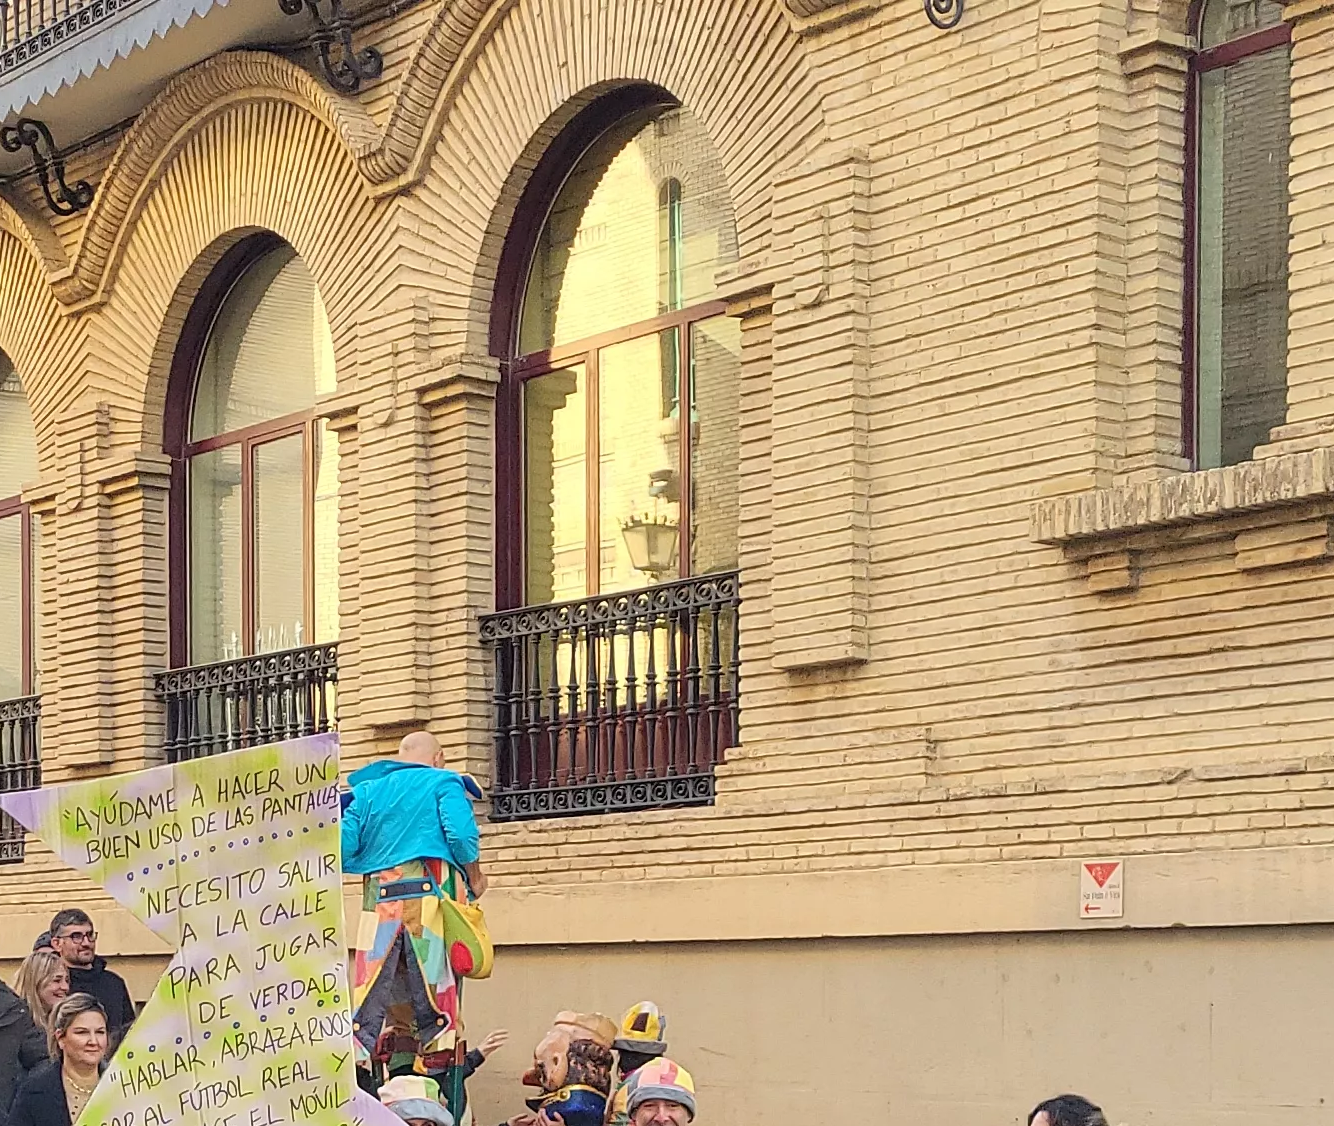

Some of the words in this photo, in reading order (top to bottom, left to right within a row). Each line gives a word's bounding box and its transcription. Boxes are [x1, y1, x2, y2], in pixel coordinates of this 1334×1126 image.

[191, 783, 206, 808] A
[217, 768, 286, 803] HACER
[295, 754, 332, 786] UN
[85, 829, 141, 865] BUEN
[149, 822, 183, 850] USO
[191, 812, 216, 838] DE
[225, 804, 255, 831] LAS
[278, 853, 338, 889] SALIR
[180, 923, 198, 947] A
[216, 909, 249, 937] LA
[259, 889, 329, 925] CALLE
[168, 953, 241, 999] PARA
[255, 927, 338, 971] JUGAR
[198, 994, 234, 1024] DE
[220, 1008, 353, 1064] ABRAZARNOS
[179, 1074, 254, 1117] FÚTBOL
[262, 1059, 320, 1092] REAL
[331, 1051, 350, 1073] Y
